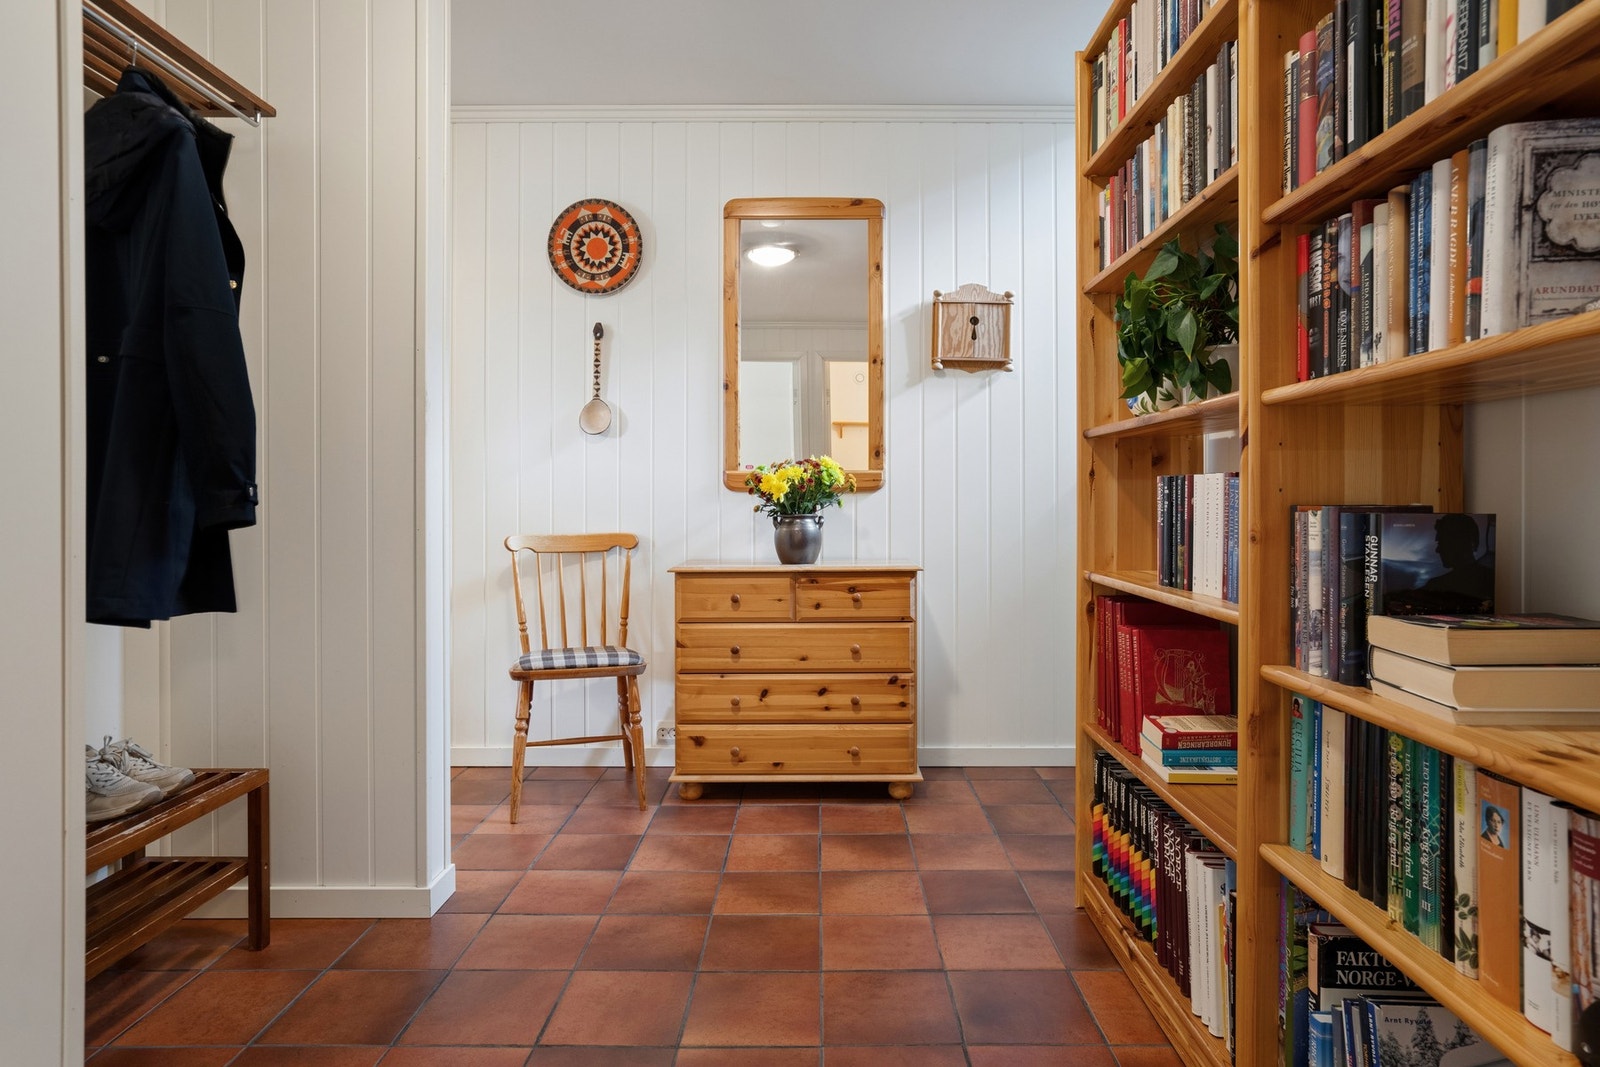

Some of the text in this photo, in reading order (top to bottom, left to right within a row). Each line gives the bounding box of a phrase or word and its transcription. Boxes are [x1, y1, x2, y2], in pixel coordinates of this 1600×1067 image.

[1450, 167, 1460, 202] ANNE
[1449, 218, 1458, 268] RAGDE
[1535, 285, 1600, 294] ARUNDHAT
[1340, 308, 1348, 367] TOVE NILSEN
[1369, 534, 1379, 582] GUNNAR
[1340, 564, 1348, 599] Staalesen
[1340, 602, 1348, 628] Dødens
[1340, 629, 1348, 663] drabanter
[1294, 721, 1303, 773] CECILIA
[1404, 752, 1412, 772] LEO
[1422, 761, 1430, 780] LEO
[1403, 773, 1412, 811] TOLSTOJ
[1421, 782, 1430, 821] TOLSTOJ
[1387, 808, 1400, 832] Krig
[1403, 816, 1414, 841] Krig
[1163, 823, 1171, 876] NORGE
[1421, 827, 1432, 850] Krig
[1458, 835, 1466, 869] Elisabeth
[1390, 846, 1400, 868] fred
[1404, 857, 1414, 878] fred
[1422, 867, 1432, 891] fred
[1336, 969, 1417, 987] NORGE-V
[1384, 1016, 1402, 1024] Arnt
[1369, 1034, 1378, 1065] RYVOLD
